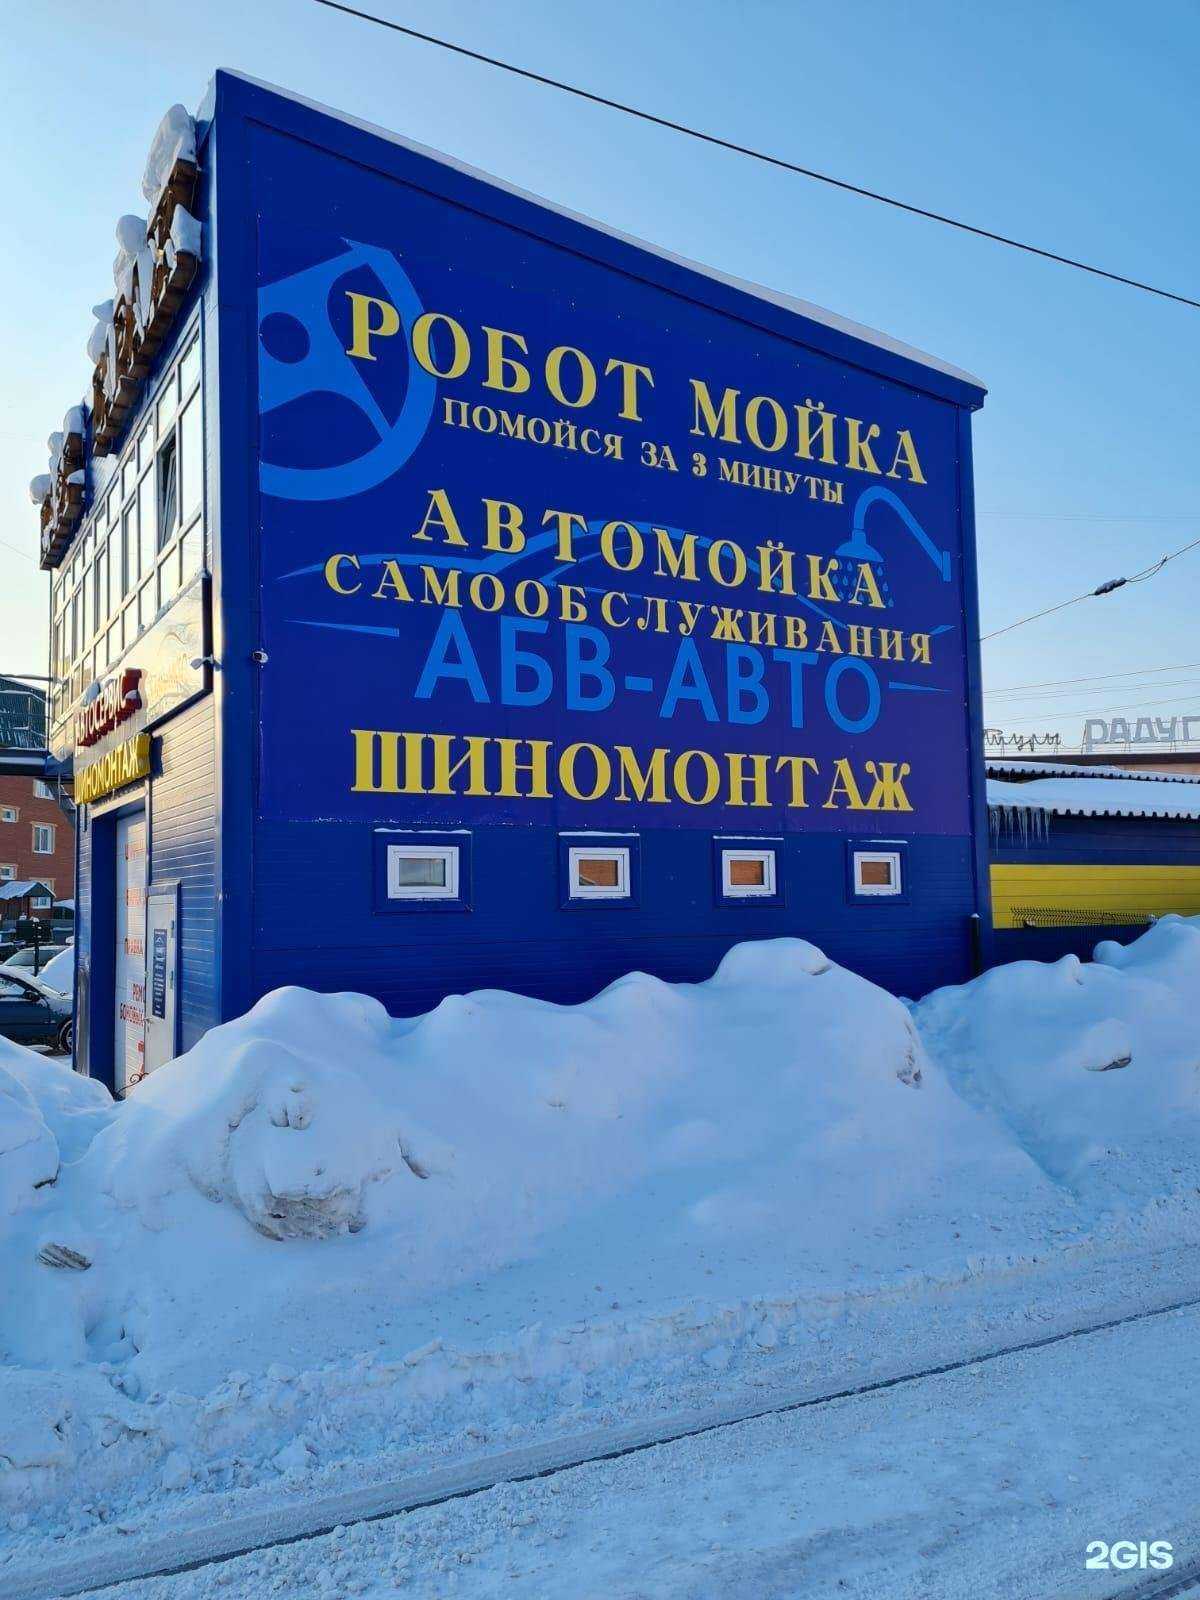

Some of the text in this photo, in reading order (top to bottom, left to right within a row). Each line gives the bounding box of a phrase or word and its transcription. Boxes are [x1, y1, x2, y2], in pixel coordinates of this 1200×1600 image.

[344, 290, 928, 485] РОБОТ МОЙКА
[442, 397, 845, 505] ПОМОЙСЯ ЗА 3 МИНУТЫ
[411, 488, 887, 609] АВТОМОЙКА
[324, 553, 933, 665] САМООБСЛУЖИВАНИЯ
[413, 606, 881, 735] АБВ-АВТО
[74, 730, 144, 806] ШИНОМОНТАЖ
[350, 728, 914, 812] ШИНОМОНТАЖ
